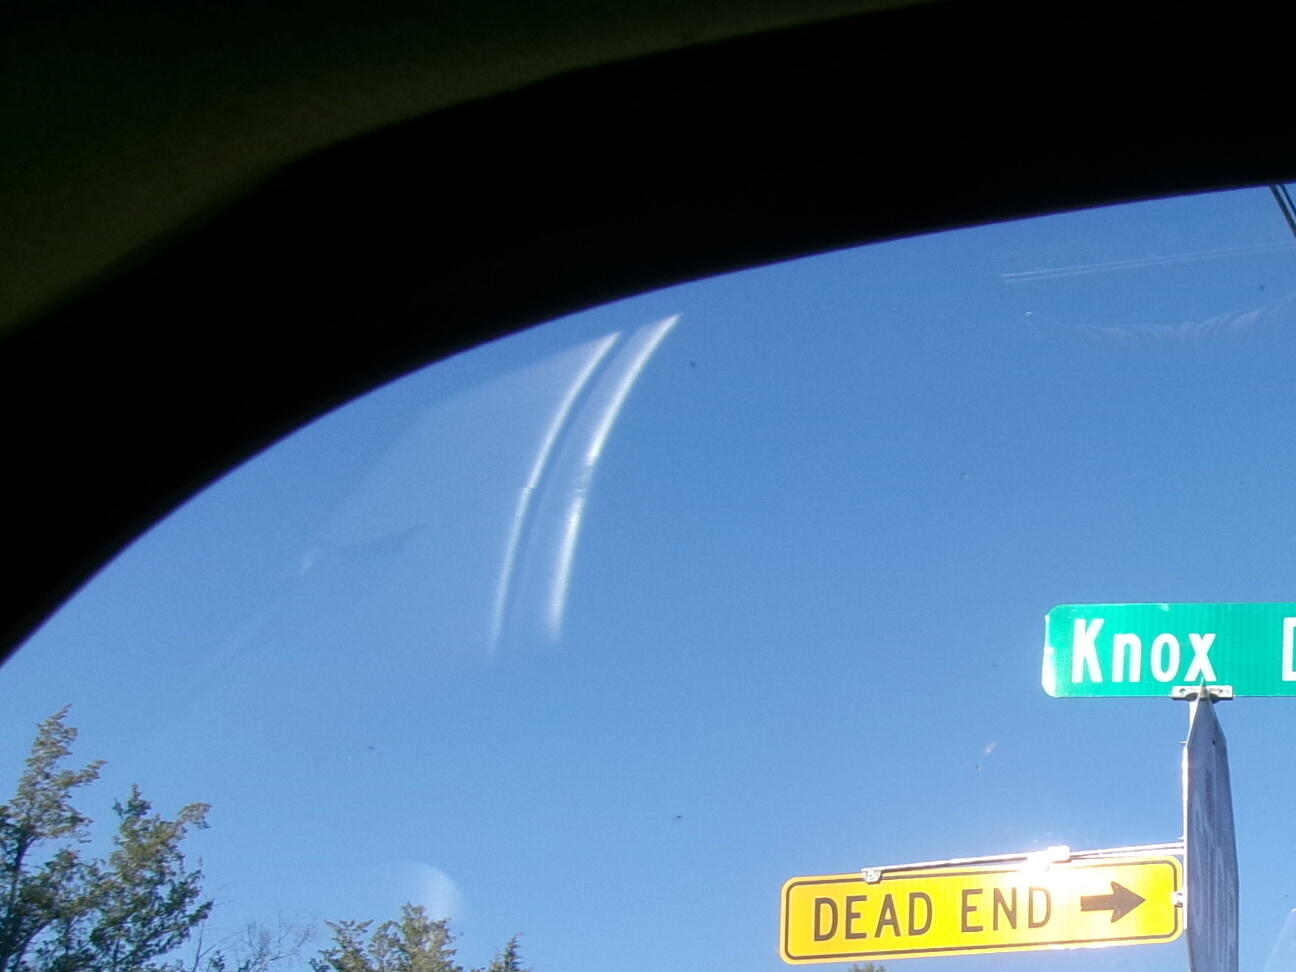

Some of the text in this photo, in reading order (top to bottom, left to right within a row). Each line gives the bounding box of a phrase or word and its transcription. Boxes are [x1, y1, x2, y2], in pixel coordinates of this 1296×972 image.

[1071, 618, 1217, 683] Knox
[813, 886, 1052, 942] DEAD END
